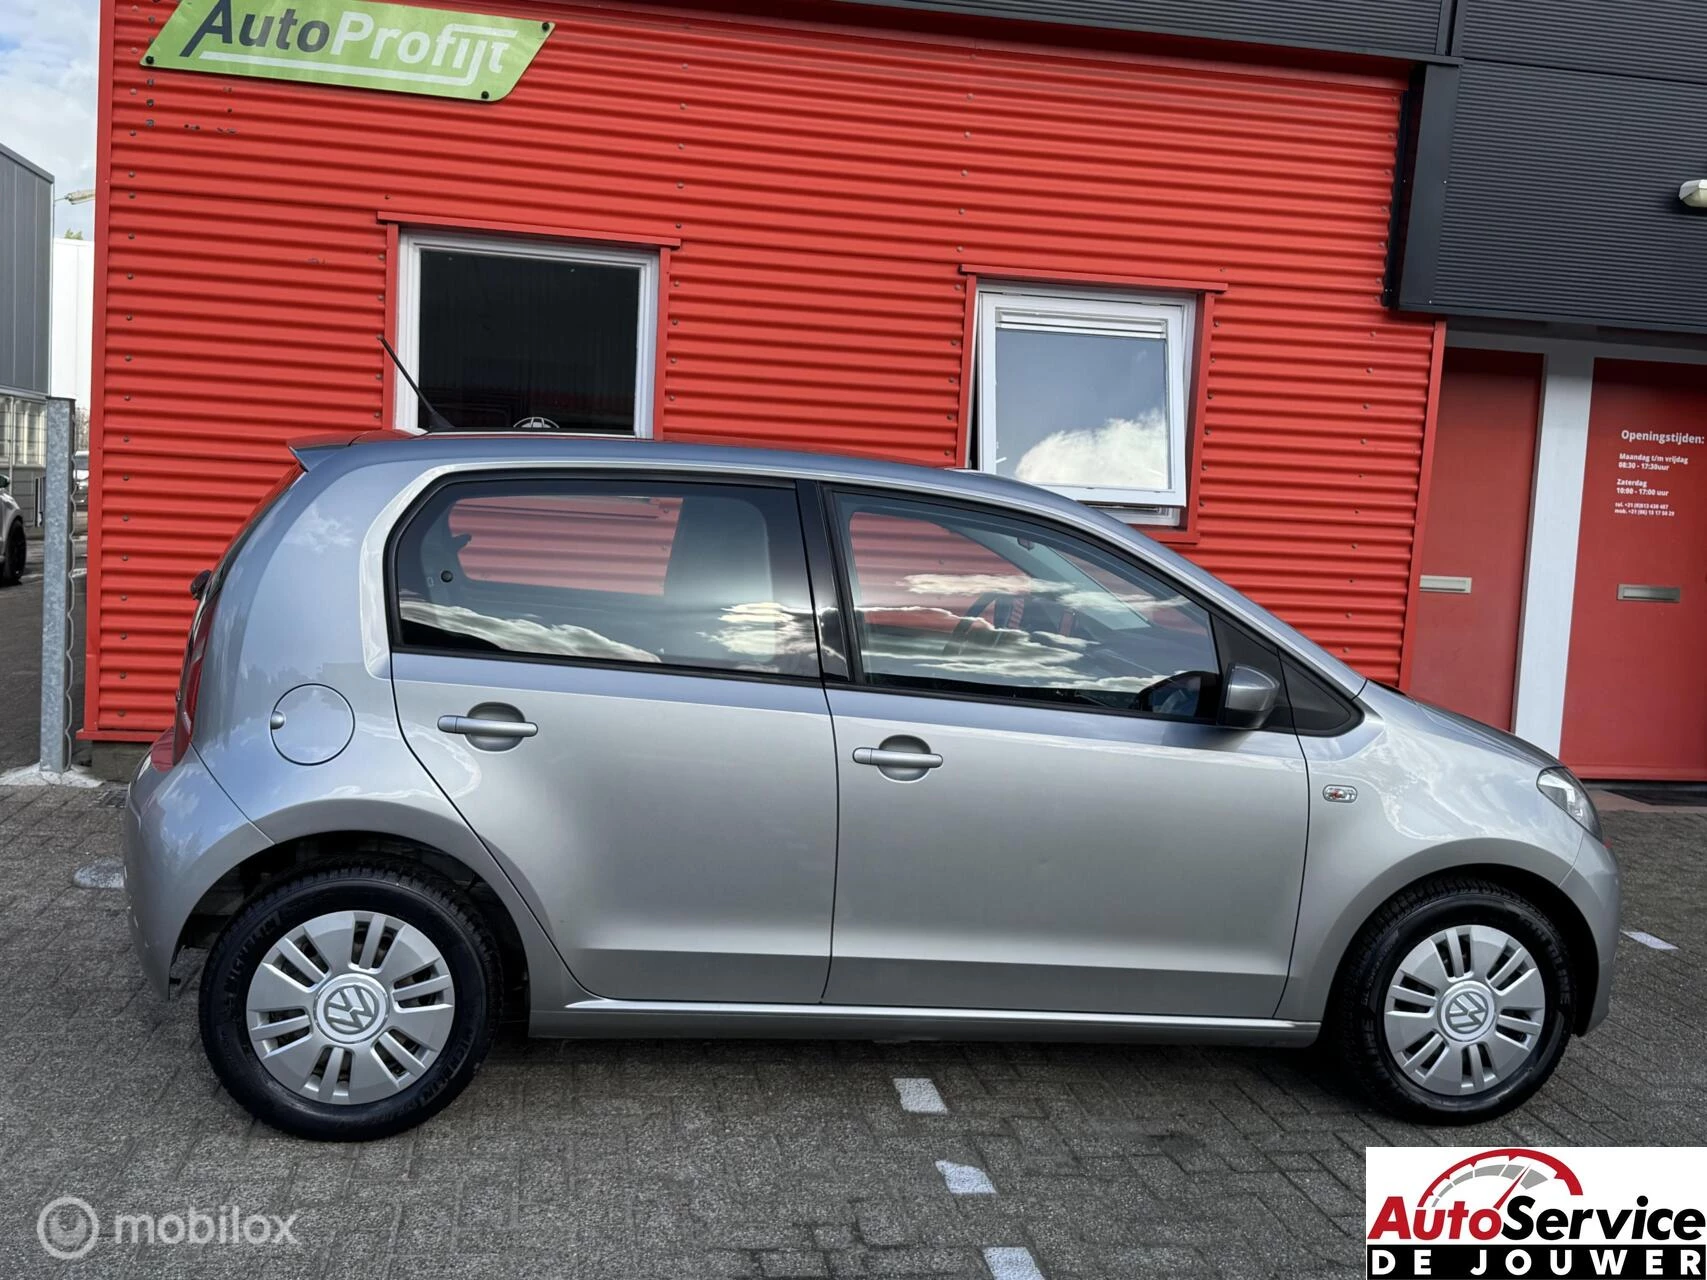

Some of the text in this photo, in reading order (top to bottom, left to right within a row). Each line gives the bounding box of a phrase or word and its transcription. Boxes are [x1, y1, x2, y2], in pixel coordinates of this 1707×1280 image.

[1621, 430, 1705, 445] Openingstijden:
[1619, 453, 1650, 462] Maandag
[1665, 455, 1688, 464] vrijdag
[1617, 479, 1647, 488] Zaterdag
